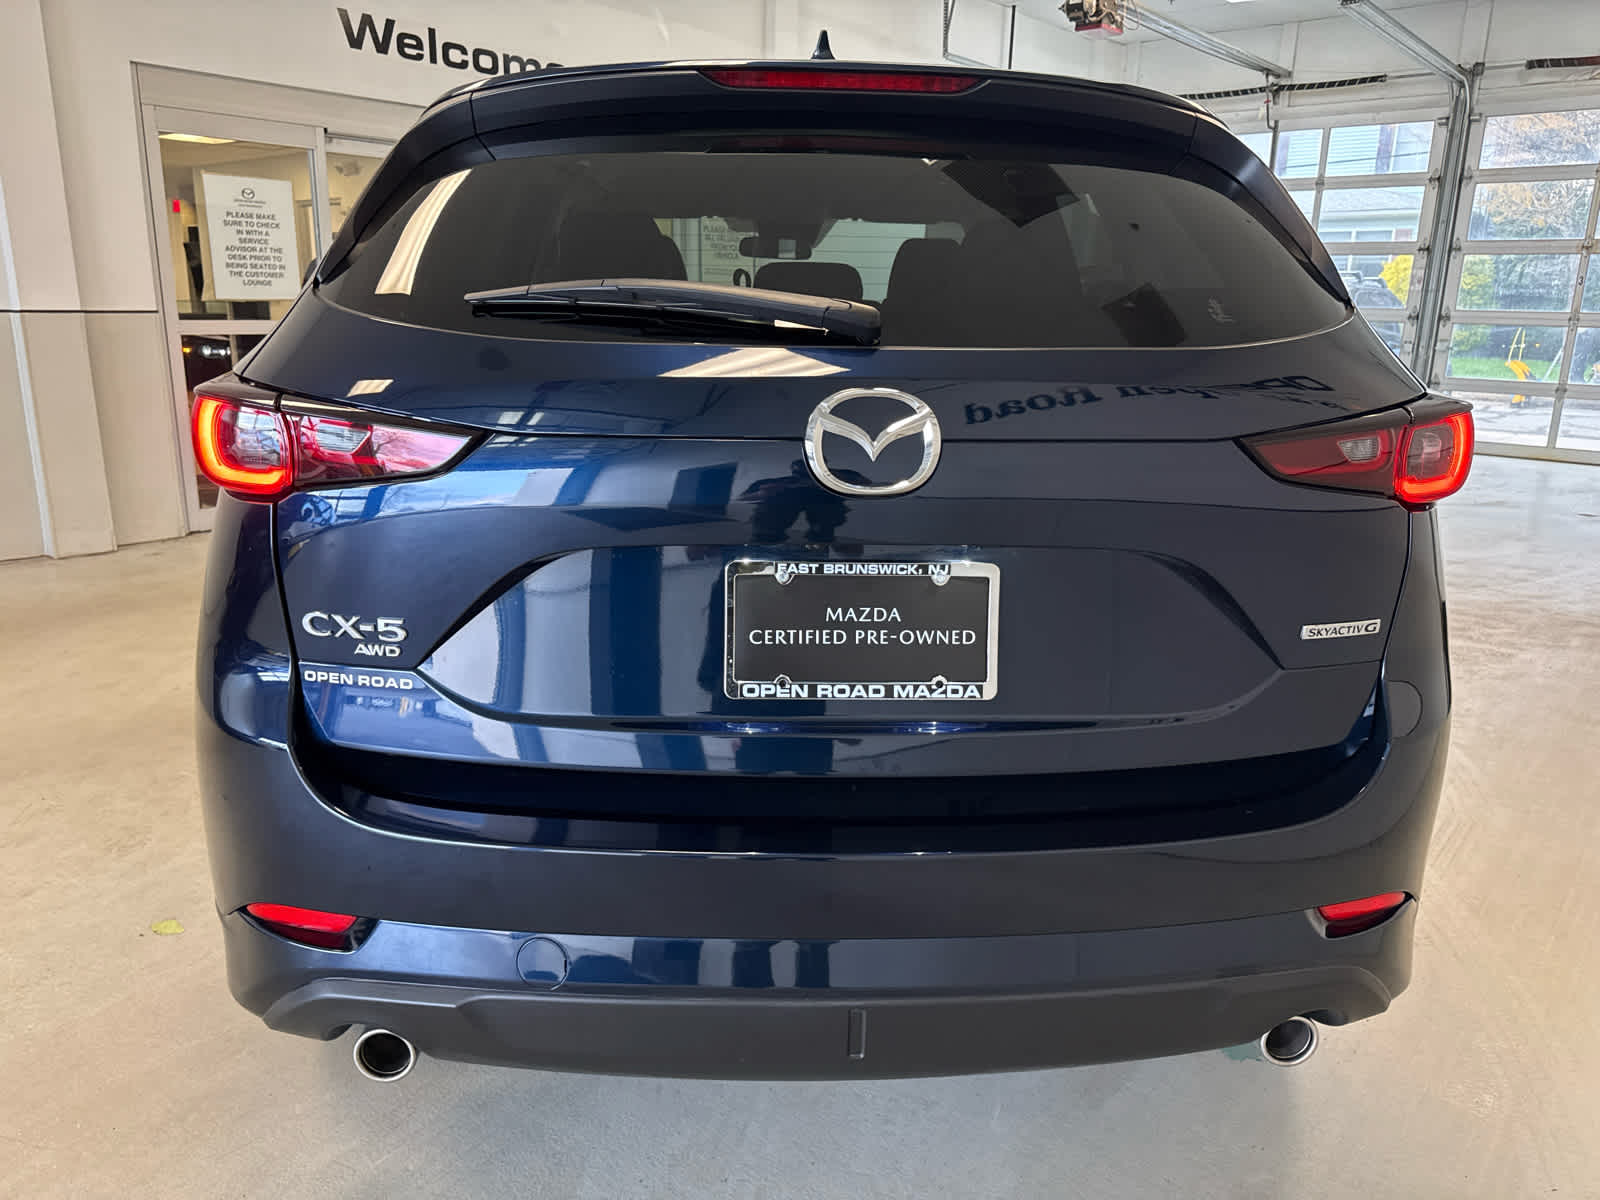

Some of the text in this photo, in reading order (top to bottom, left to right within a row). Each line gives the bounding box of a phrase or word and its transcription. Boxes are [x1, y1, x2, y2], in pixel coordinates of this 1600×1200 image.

[225, 262, 248, 270] BEING
[250, 263, 277, 271] SEATED
[242, 279, 272, 287] LOUNGE
[776, 563, 949, 577] EAST BRUNSWICK, NJ
[825, 607, 902, 622] MAZDA
[302, 611, 407, 642] CX-5
[749, 630, 976, 645] CERTIFIED PRE-OWNED
[354, 643, 401, 657] AWD
[304, 670, 413, 690] OPEN ROAD
[742, 684, 981, 698] OPEN ROAD MAZDA
